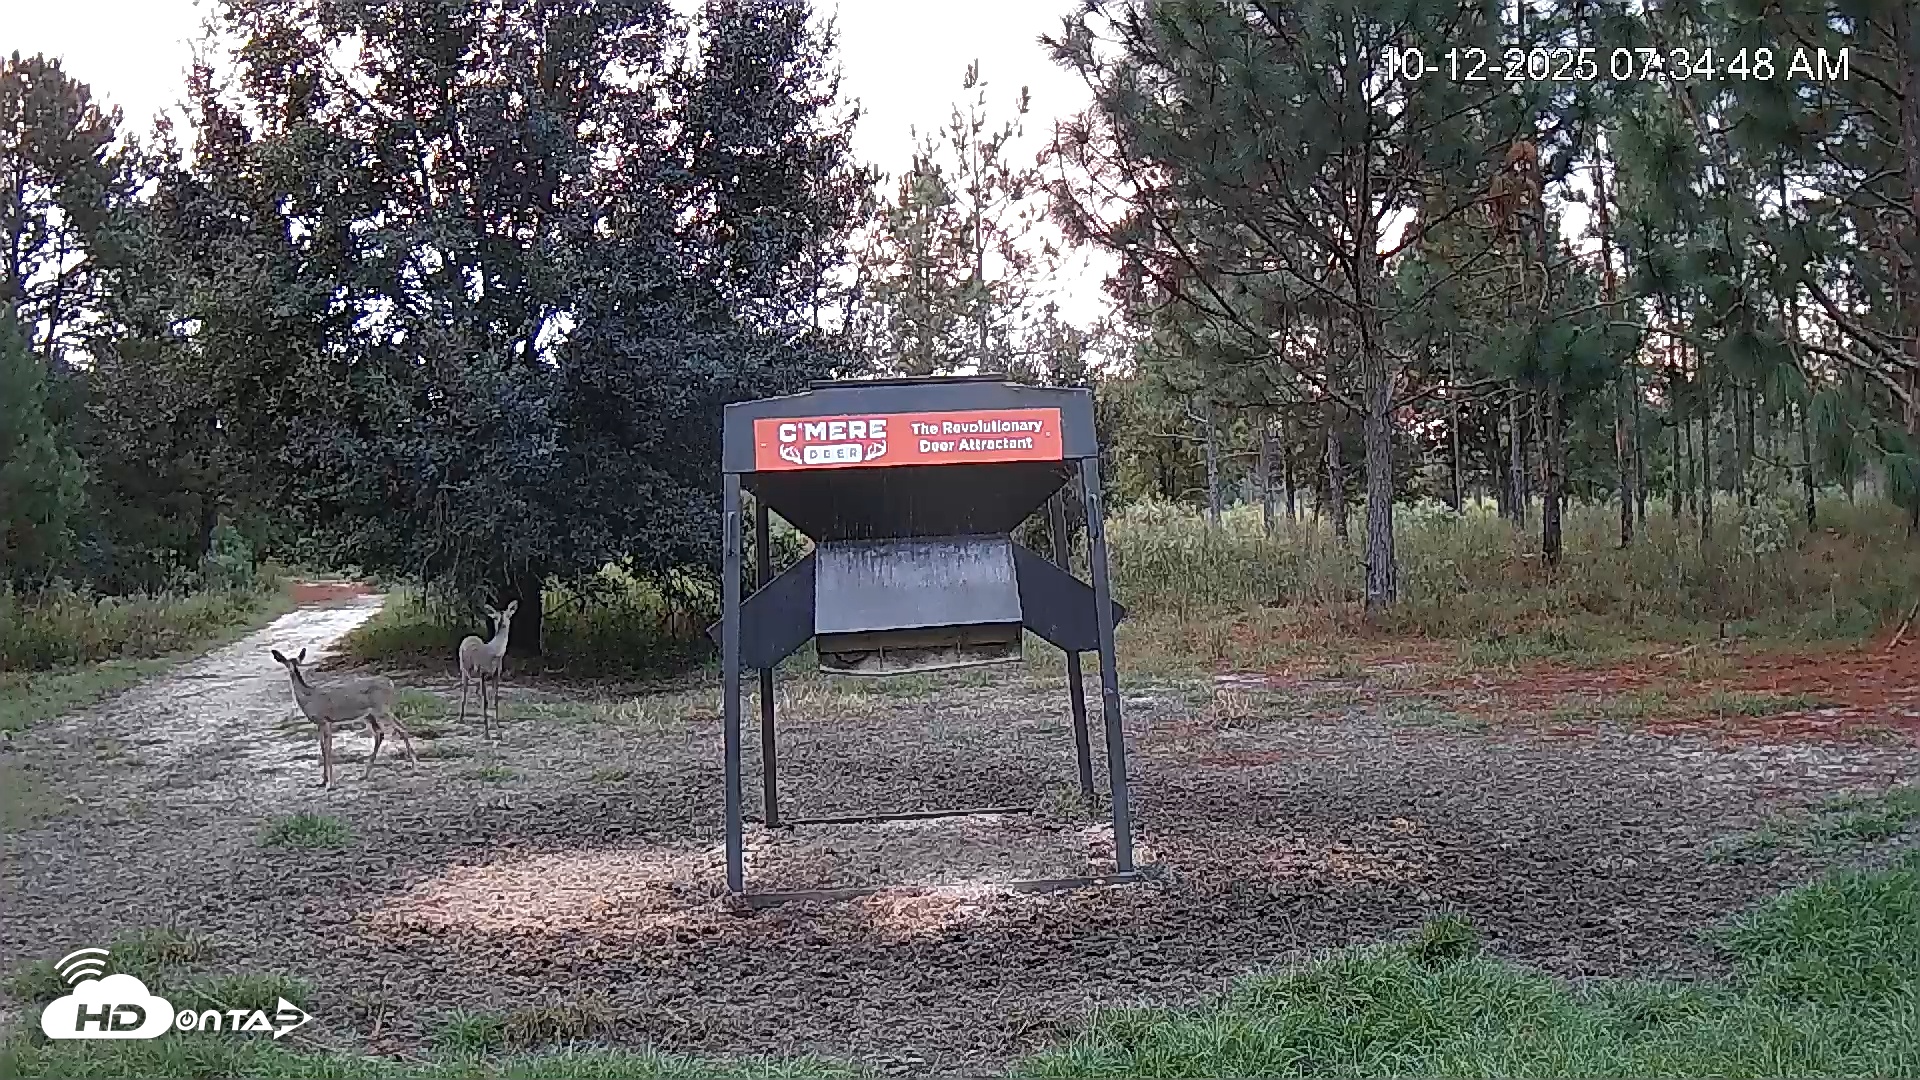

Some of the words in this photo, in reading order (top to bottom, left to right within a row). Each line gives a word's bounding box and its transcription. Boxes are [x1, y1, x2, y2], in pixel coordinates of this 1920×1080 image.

[780, 420, 887, 442] C'MERE
[911, 423, 939, 435] The
[943, 419, 1042, 435] Revolutionary
[919, 439, 955, 453] Deer
[958, 436, 1033, 451] Attractant
[809, 447, 858, 460] DEER
